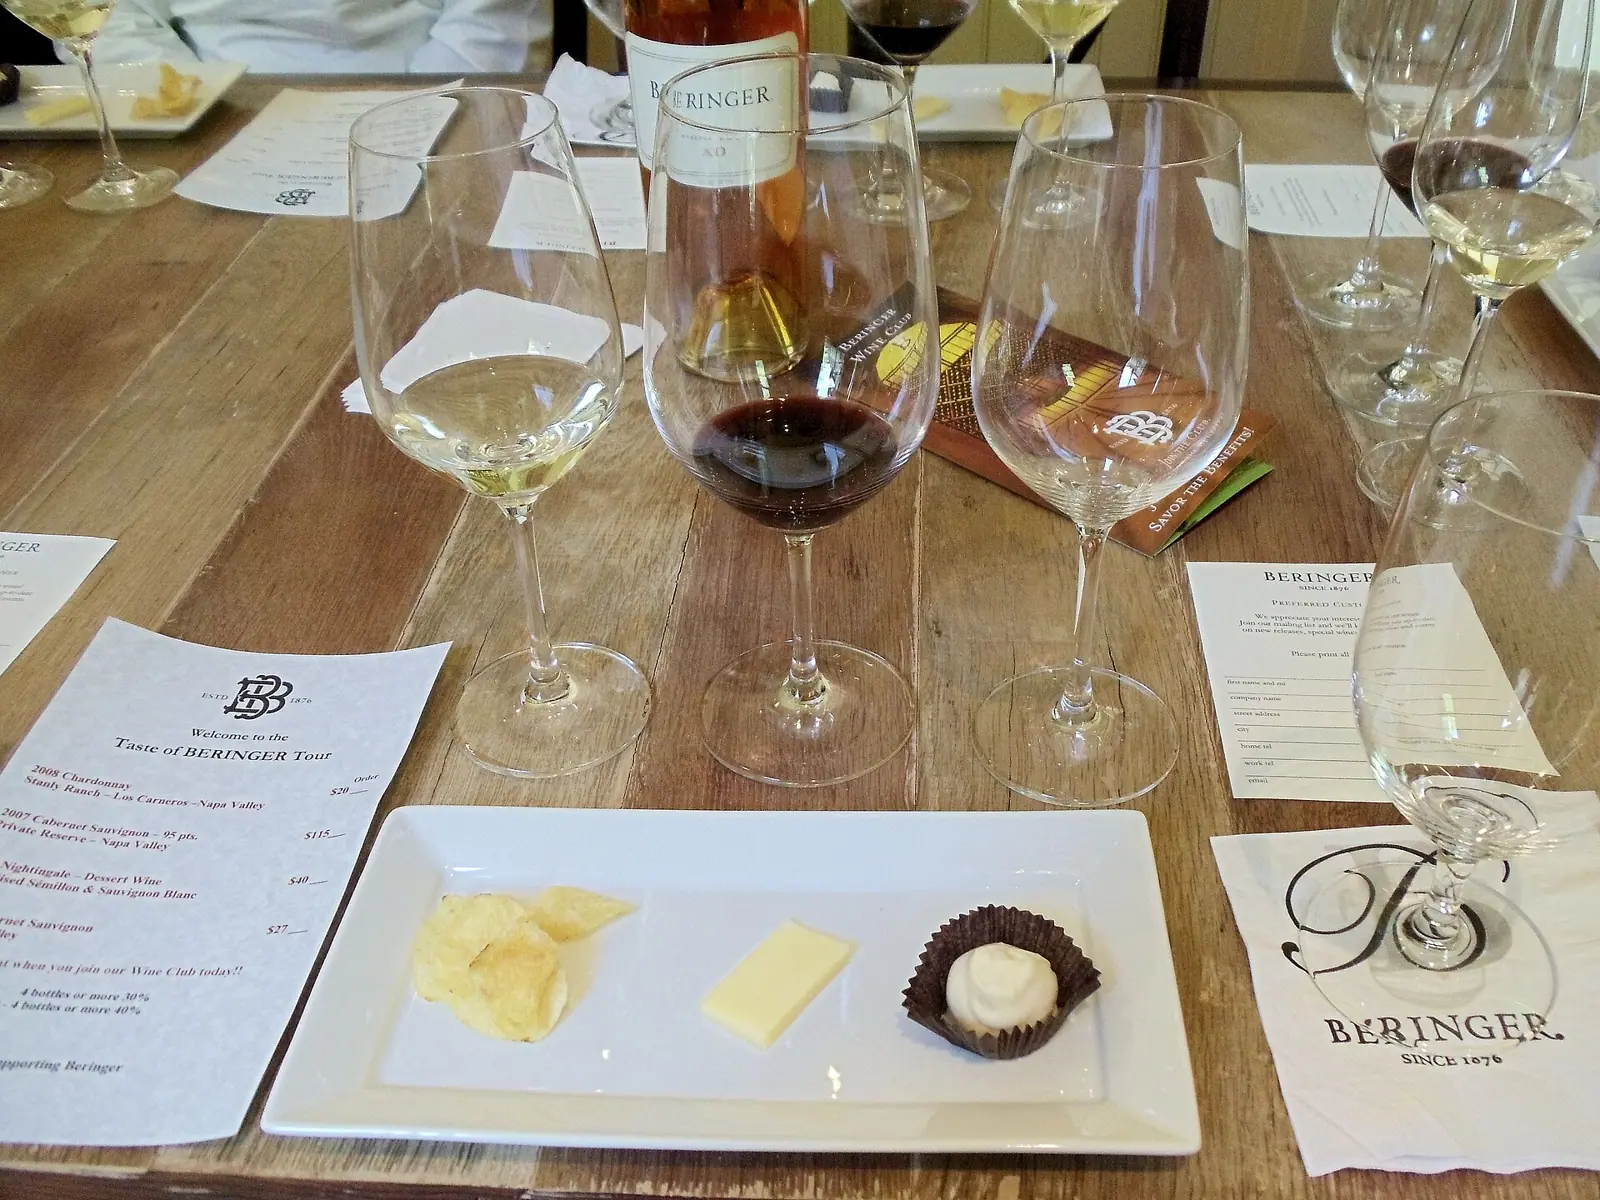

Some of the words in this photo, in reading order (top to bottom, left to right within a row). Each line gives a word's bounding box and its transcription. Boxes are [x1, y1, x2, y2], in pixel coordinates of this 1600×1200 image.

[650, 79, 773, 109] BERINGER
[839, 308, 897, 351] BERINGER
[850, 337, 887, 362] WINE
[884, 312, 912, 336] CLUB
[1175, 437, 1189, 456] THE
[1149, 497, 1188, 532] SAVOR
[1183, 474, 1208, 496] THE
[1204, 426, 1255, 476] BENEFITS!
[0, 541, 40, 552] GER
[1238, 619, 1256, 627] Join
[1291, 650, 1316, 658] Please
[1318, 651, 1340, 659] print
[192, 728, 249, 742] Welcome
[252, 733, 265, 742] to
[269, 733, 289, 742] the
[115, 736, 159, 755] Taste
[163, 746, 183, 757] of
[183, 747, 288, 762] BERINGER
[293, 751, 333, 762] Tour
[31, 764, 59, 778] 2008
[62, 771, 132, 791] Chardonnay
[353, 773, 379, 783] Order
[24, 775, 61, 792] Stanly
[64, 784, 100, 798] Ranch
[113, 792, 133, 802] Los
[137, 794, 188, 807] Carneros
[231, 801, 265, 811] Valley
[330, 786, 349, 796] $20
[1, 808, 31, 821] 2007
[32, 815, 87, 831] Cabernet
[90, 824, 149, 839] Sauvignon
[163, 831, 177, 839] 95
[178, 832, 198, 841] pts.
[40, 829, 87, 844] Reserve
[100, 837, 130, 849] Napa
[134, 840, 170, 852] Valley
[303, 829, 331, 841] $115
[1, 860, 71, 879] Nightingale
[84, 872, 129, 885] Dessert
[132, 876, 163, 887] Wine
[288, 876, 309, 886] $40
[83, 885, 94, 894] &
[97, 886, 160, 899] Sauvignon
[163, 890, 197, 900] Blanc
[27, 919, 94, 934] Sauvignon
[266, 925, 289, 935] $27
[12, 960, 46, 971] when
[48, 963, 74, 974] you
[73, 965, 101, 975] join
[104, 967, 126, 975] our
[131, 966, 163, 977] Wine
[166, 966, 196, 977] Club
[30, 988, 70, 1000] bottles
[73, 991, 87, 1000] or
[89, 993, 120, 1001] more
[21, 1000, 61, 1012] bottles
[64, 1005, 78, 1014] or
[80, 1006, 111, 1015] more
[114, 1005, 142, 1016] 40%
[1324, 1013, 1565, 1046] BERINGER
[64, 1060, 124, 1075] Beringer
[1401, 1053, 1458, 1067] SINCE
